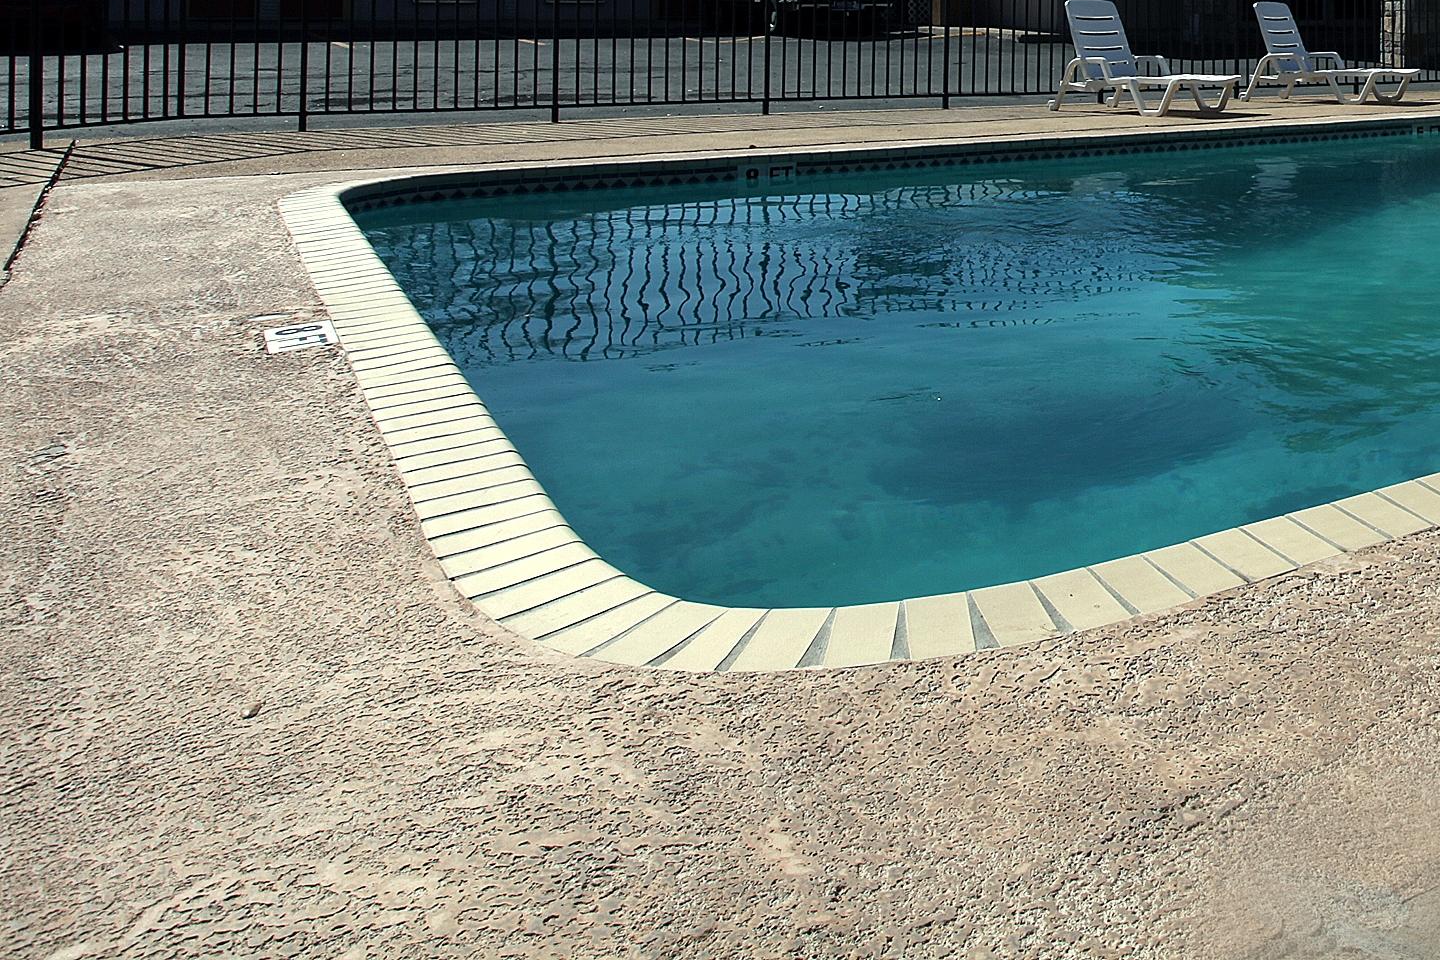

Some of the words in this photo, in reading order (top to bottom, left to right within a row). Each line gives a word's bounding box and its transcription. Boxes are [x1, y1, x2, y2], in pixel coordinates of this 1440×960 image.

[769, 165, 793, 179] FT
[275, 324, 323, 336] 8
[279, 333, 328, 349] FT
